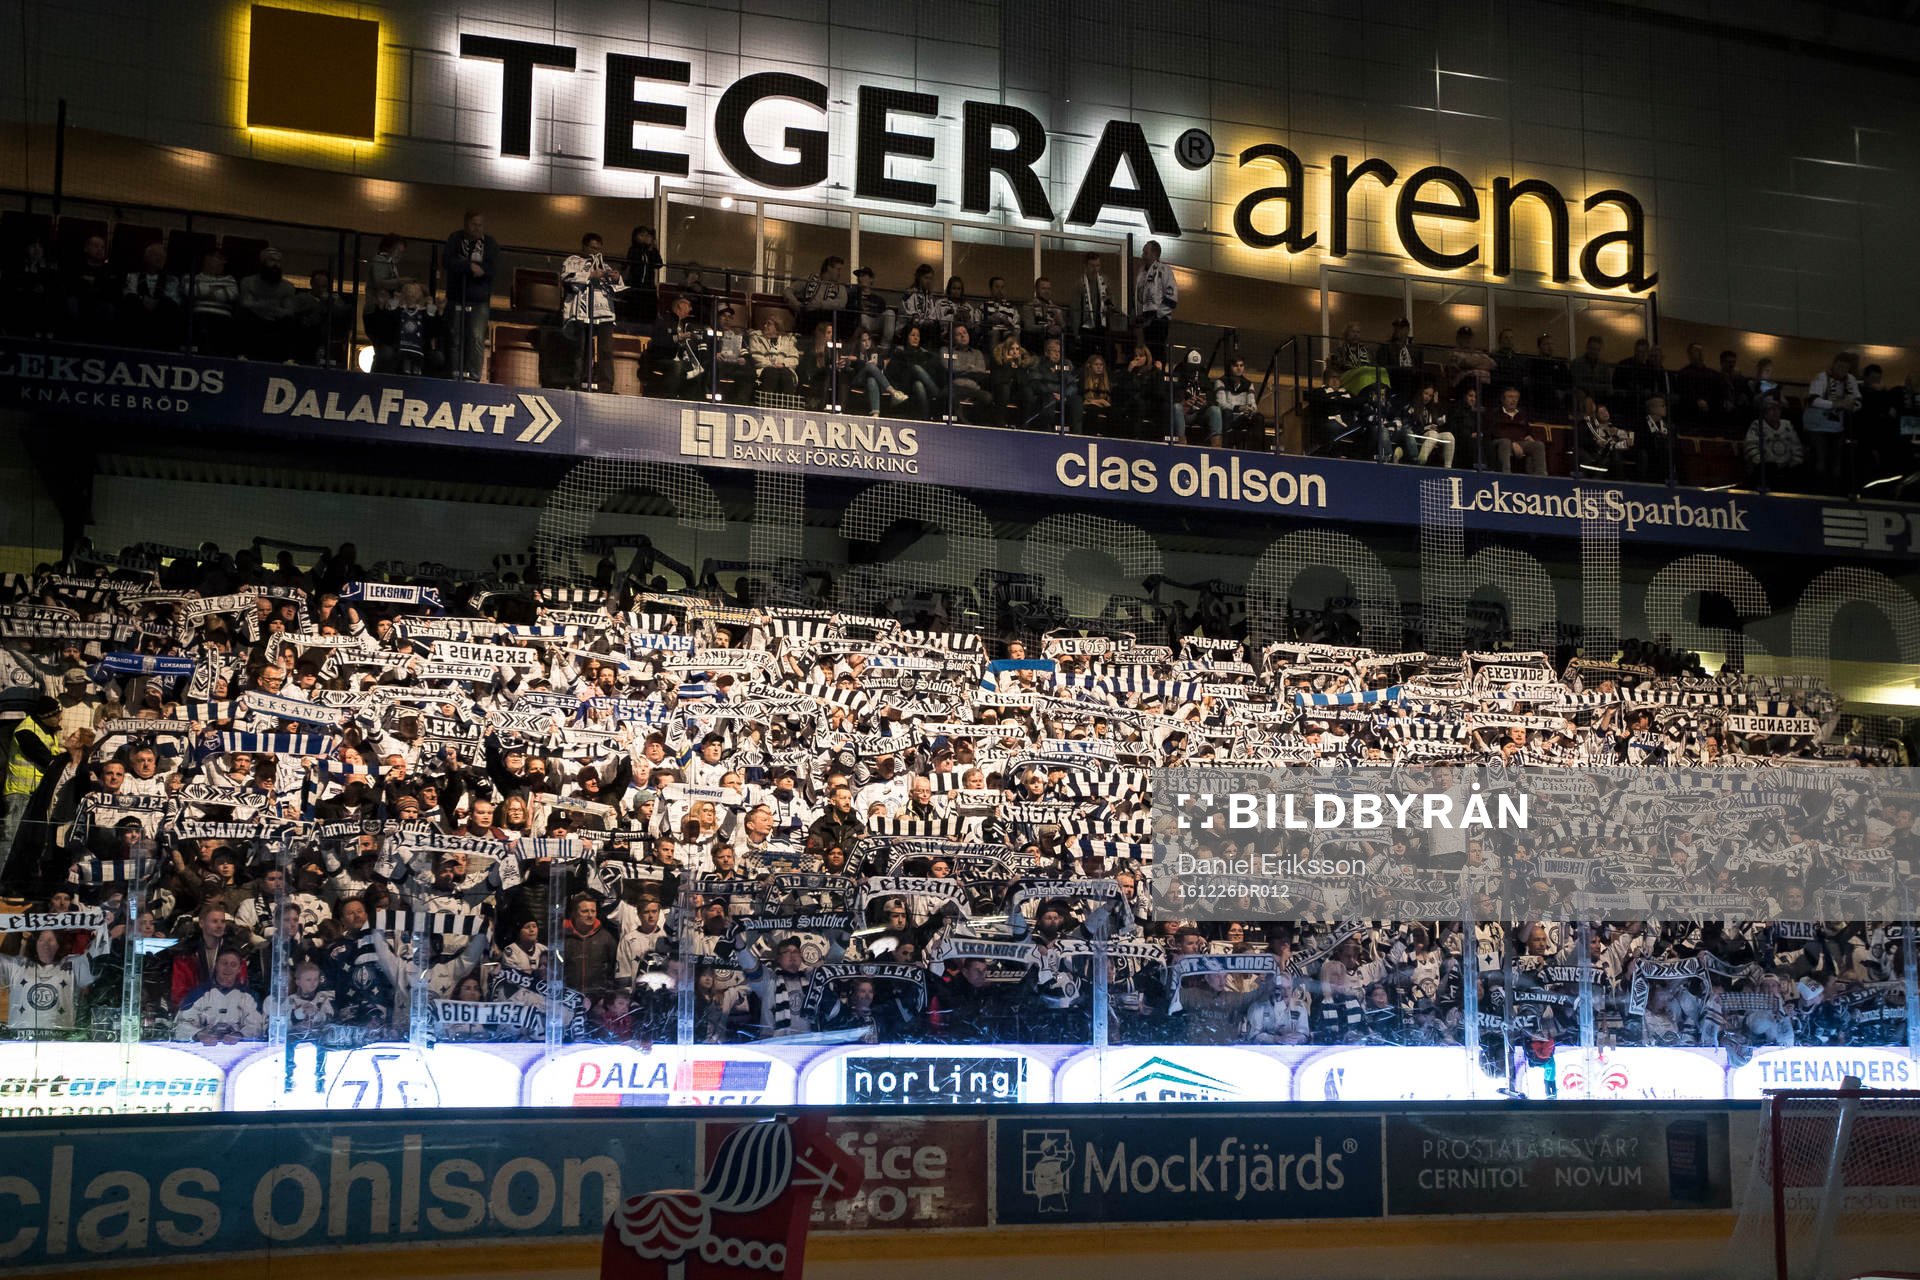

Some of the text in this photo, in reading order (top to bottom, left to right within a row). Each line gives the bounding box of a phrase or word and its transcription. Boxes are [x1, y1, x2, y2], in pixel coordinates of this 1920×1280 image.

[1233, 143, 1659, 295] arena
[20, 386, 190, 414] KNÄCKEBRÖD
[732, 413, 919, 457] DALARNAS
[733, 445, 919, 475] BANK & FÖRSÄKRING
[1056, 442, 1327, 507] clas ohlson
[1449, 476, 1750, 532] Leksands Sparbank
[369, 586, 413, 600] LEKSAND
[1, 619, 112, 639] LEKSANDS
[114, 623, 135, 642] IF
[408, 625, 460, 639] LEKSANDS IF
[837, 614, 896, 630] KRIGARE
[631, 634, 694, 652] STARS
[1114, 652, 1160, 664] Krigare
[428, 664, 493, 681] LEKSAND
[425, 717, 486, 741] LEKSA
[683, 786, 724, 798] Leksand
[174, 822, 277, 840] LEKSANDS IF
[395, 830, 506, 862] Leksand
[1543, 860, 1588, 875] LEKSAND
[865, 877, 968, 907] Leksand
[1021, 880, 1120, 898] LEKSAND
[740, 913, 848, 931] Dalarnas Stolthet
[1779, 921, 1819, 938] STARS
[954, 941, 1029, 959] LEKSANDS IF
[806, 965, 858, 1012] LEKSAND
[441, 1003, 479, 1023] 1919
[1476, 1011, 1537, 1030] RIGRE
[576, 1062, 669, 1089] DALA
[853, 1064, 1009, 1096] norling
[1758, 1059, 1911, 1083] THENANDERS
[1083, 1136, 1359, 1202] Mockfjärds®
[1418, 1167, 1643, 1191] CERNITOL NOVUM
[0, 1133, 623, 1259] clas ohlson
